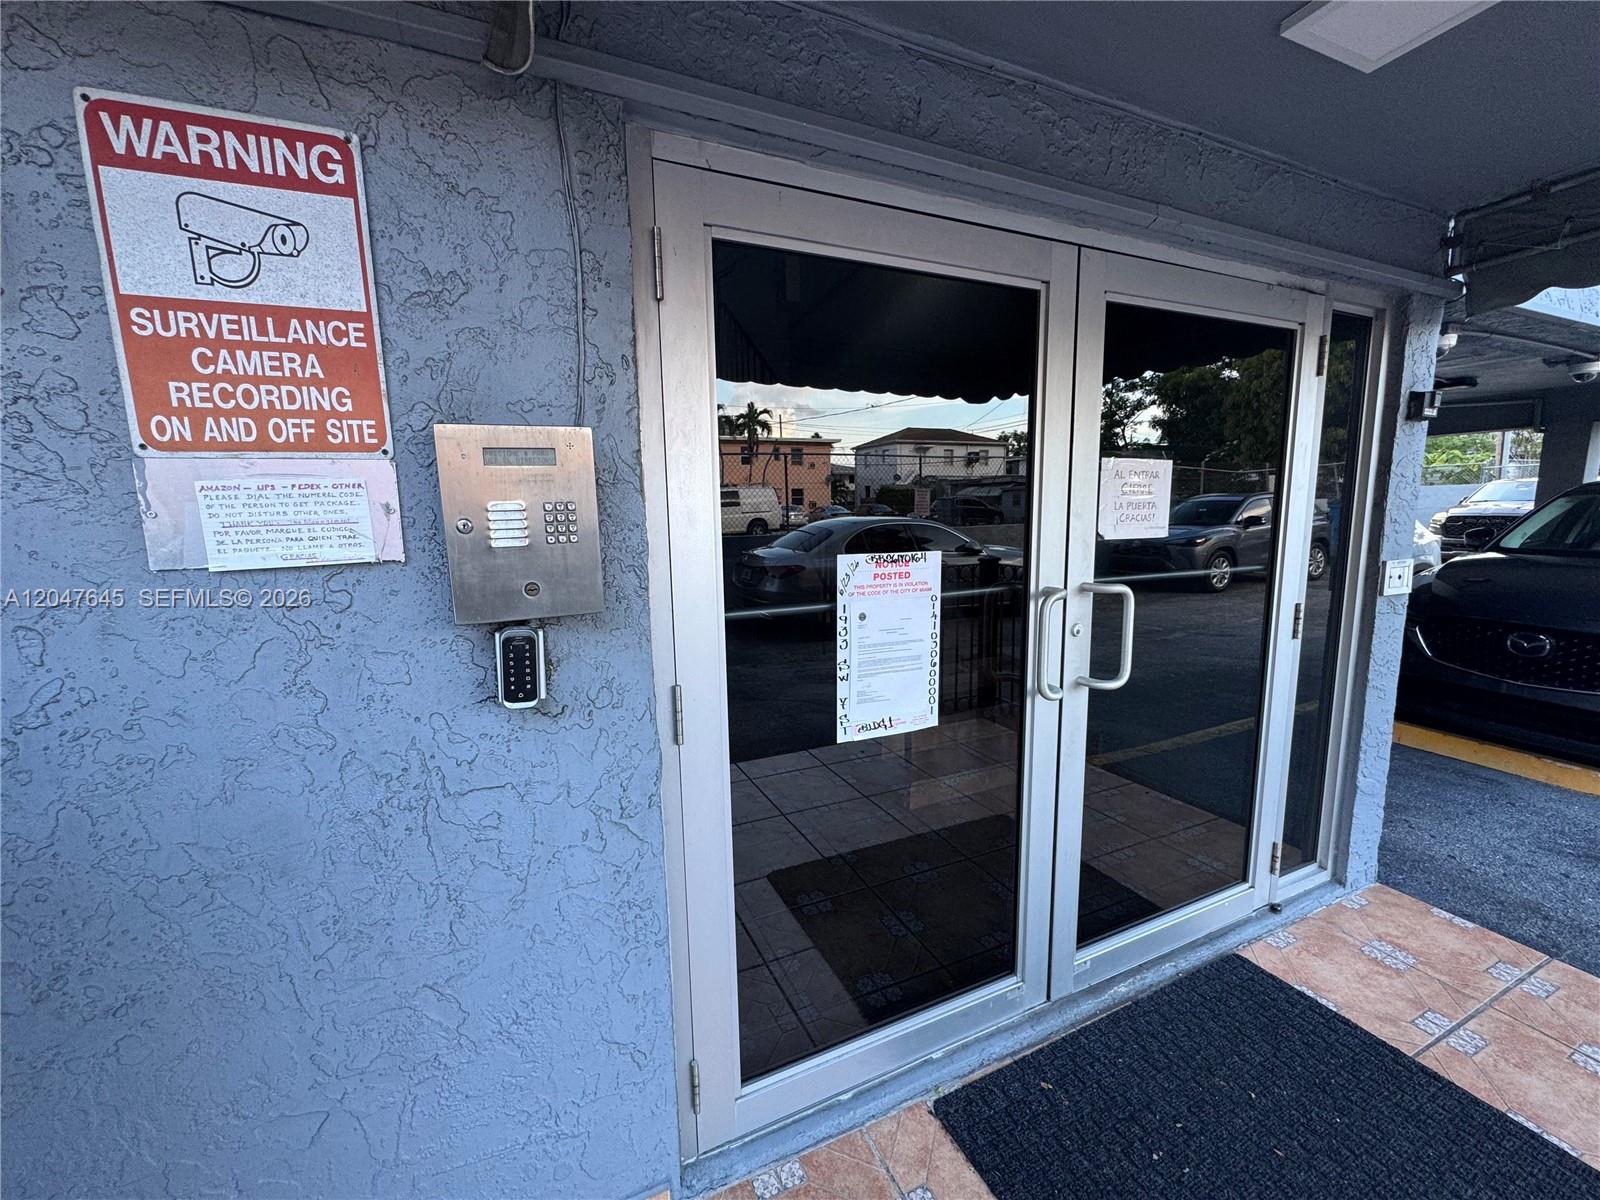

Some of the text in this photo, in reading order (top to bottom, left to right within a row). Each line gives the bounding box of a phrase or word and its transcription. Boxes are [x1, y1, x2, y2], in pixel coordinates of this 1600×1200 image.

[98, 111, 345, 184] WARNING
[130, 307, 367, 348] SURVEILLANCE
[191, 347, 324, 378] CAMERA
[168, 381, 353, 411] RECORDING
[150, 415, 378, 444] ON AND OFF SITE
[1114, 470, 1126, 480] AL
[199, 484, 241, 493] AMAZON
[1114, 502, 1157, 511] LA PUERTA
[873, 571, 911, 581] POSTED
[875, 560, 910, 569] NOTICE
[838, 604, 849, 650] 1933
[838, 659, 850, 682] SW
[838, 714, 850, 735] ST
